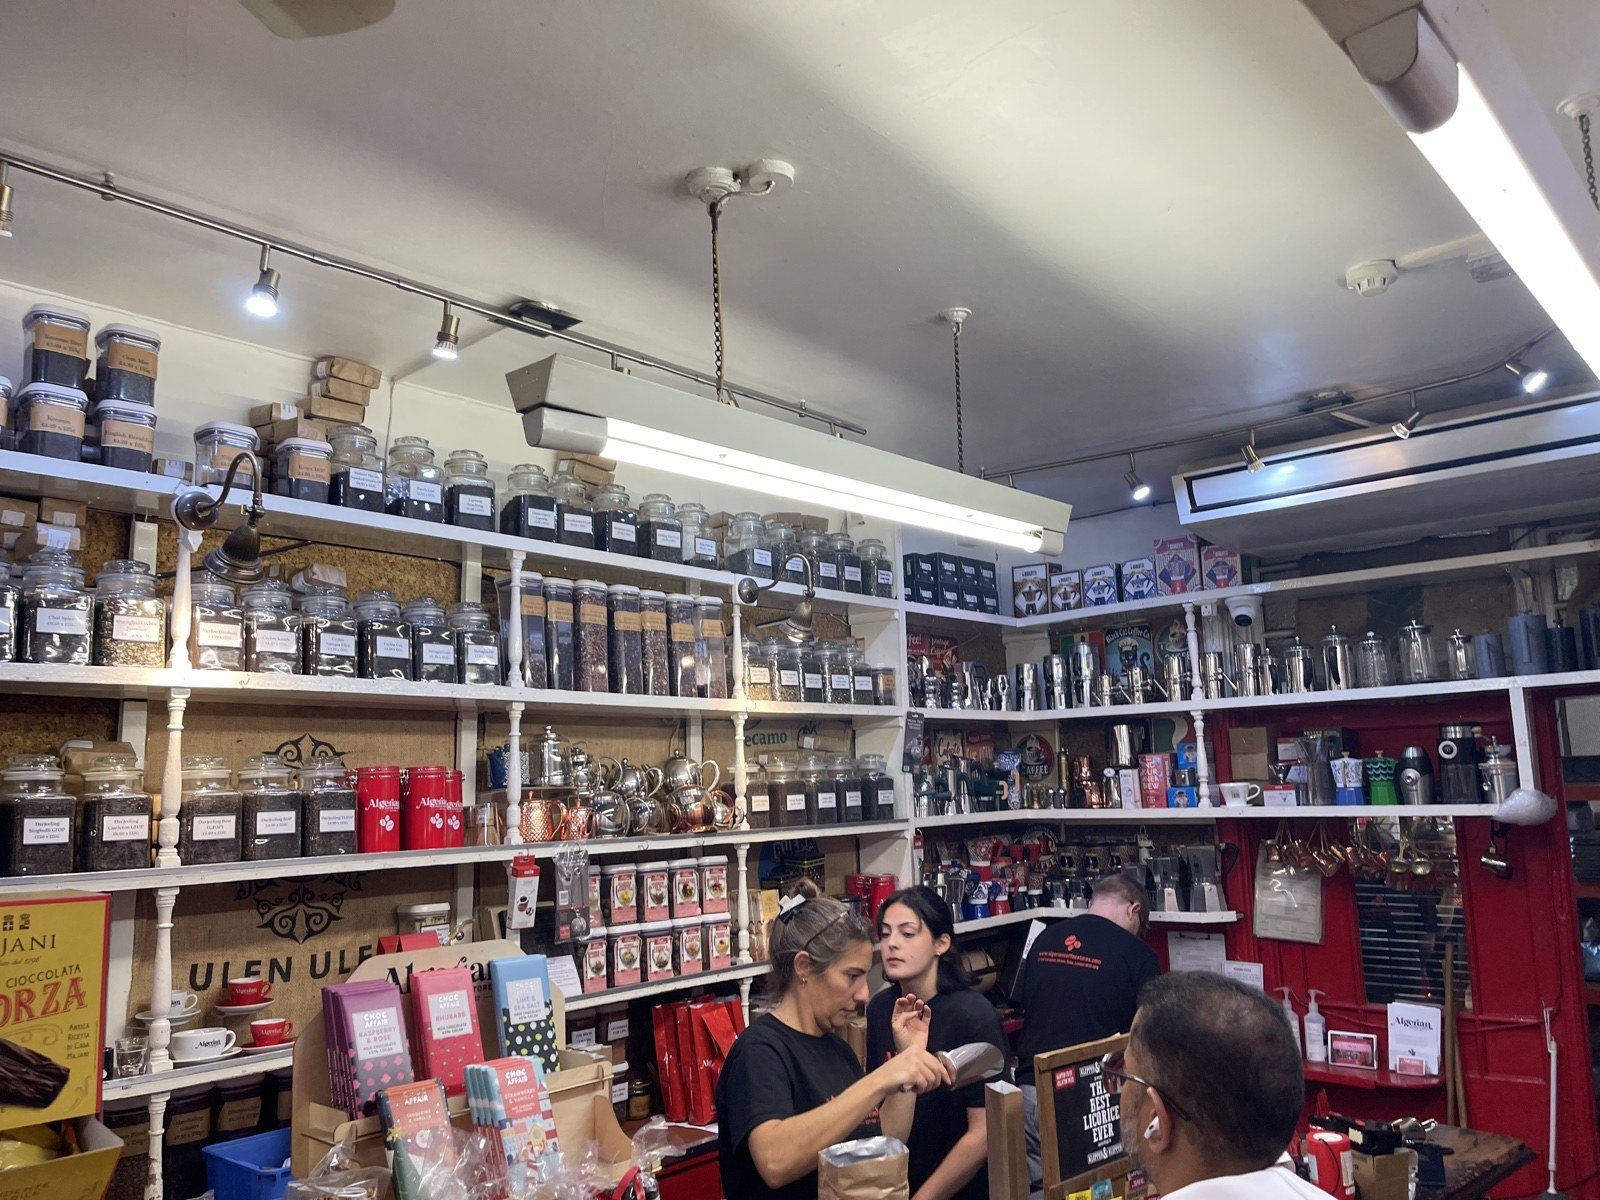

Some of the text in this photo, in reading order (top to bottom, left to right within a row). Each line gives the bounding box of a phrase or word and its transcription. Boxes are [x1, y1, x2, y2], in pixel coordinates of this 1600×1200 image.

[5, 964, 81, 988] CIOCCOLATA
[438, 994, 459, 1003] CHOC
[363, 1011, 387, 1020] CHOC
[435, 1011, 466, 1021] RHUBARB
[365, 1019, 388, 1028] AFFAIR
[1390, 1016, 1433, 1030] Algerian
[358, 1026, 396, 1037] RASPBERRY
[374, 1034, 390, 1042] ROSE
[505, 1069, 527, 1080] CHOC
[507, 1076, 528, 1086] AFFAIR
[404, 1094, 429, 1106] AFFAIR
[1089, 1093, 1110, 1113] BEST
[1083, 1105, 1120, 1131] LICORICE
[1092, 1122, 1114, 1144] EVER
